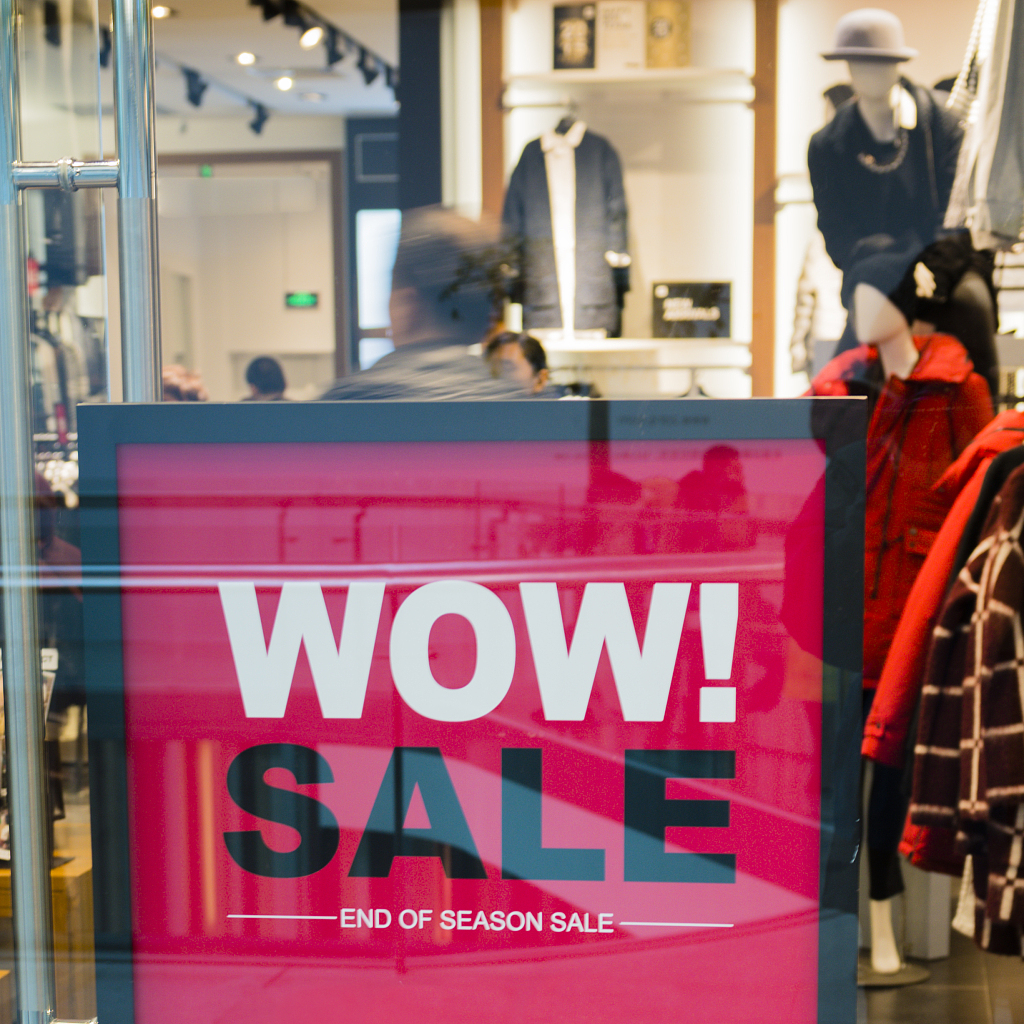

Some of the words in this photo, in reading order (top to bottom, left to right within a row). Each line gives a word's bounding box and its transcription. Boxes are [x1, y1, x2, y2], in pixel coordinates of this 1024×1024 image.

[217, 580, 738, 722] WOW!
[223, 743, 736, 883] SALE
[340, 908, 392, 929] END
[399, 909, 433, 930] OF
[440, 910, 543, 932] SEASON
[551, 912, 614, 933] SALE
